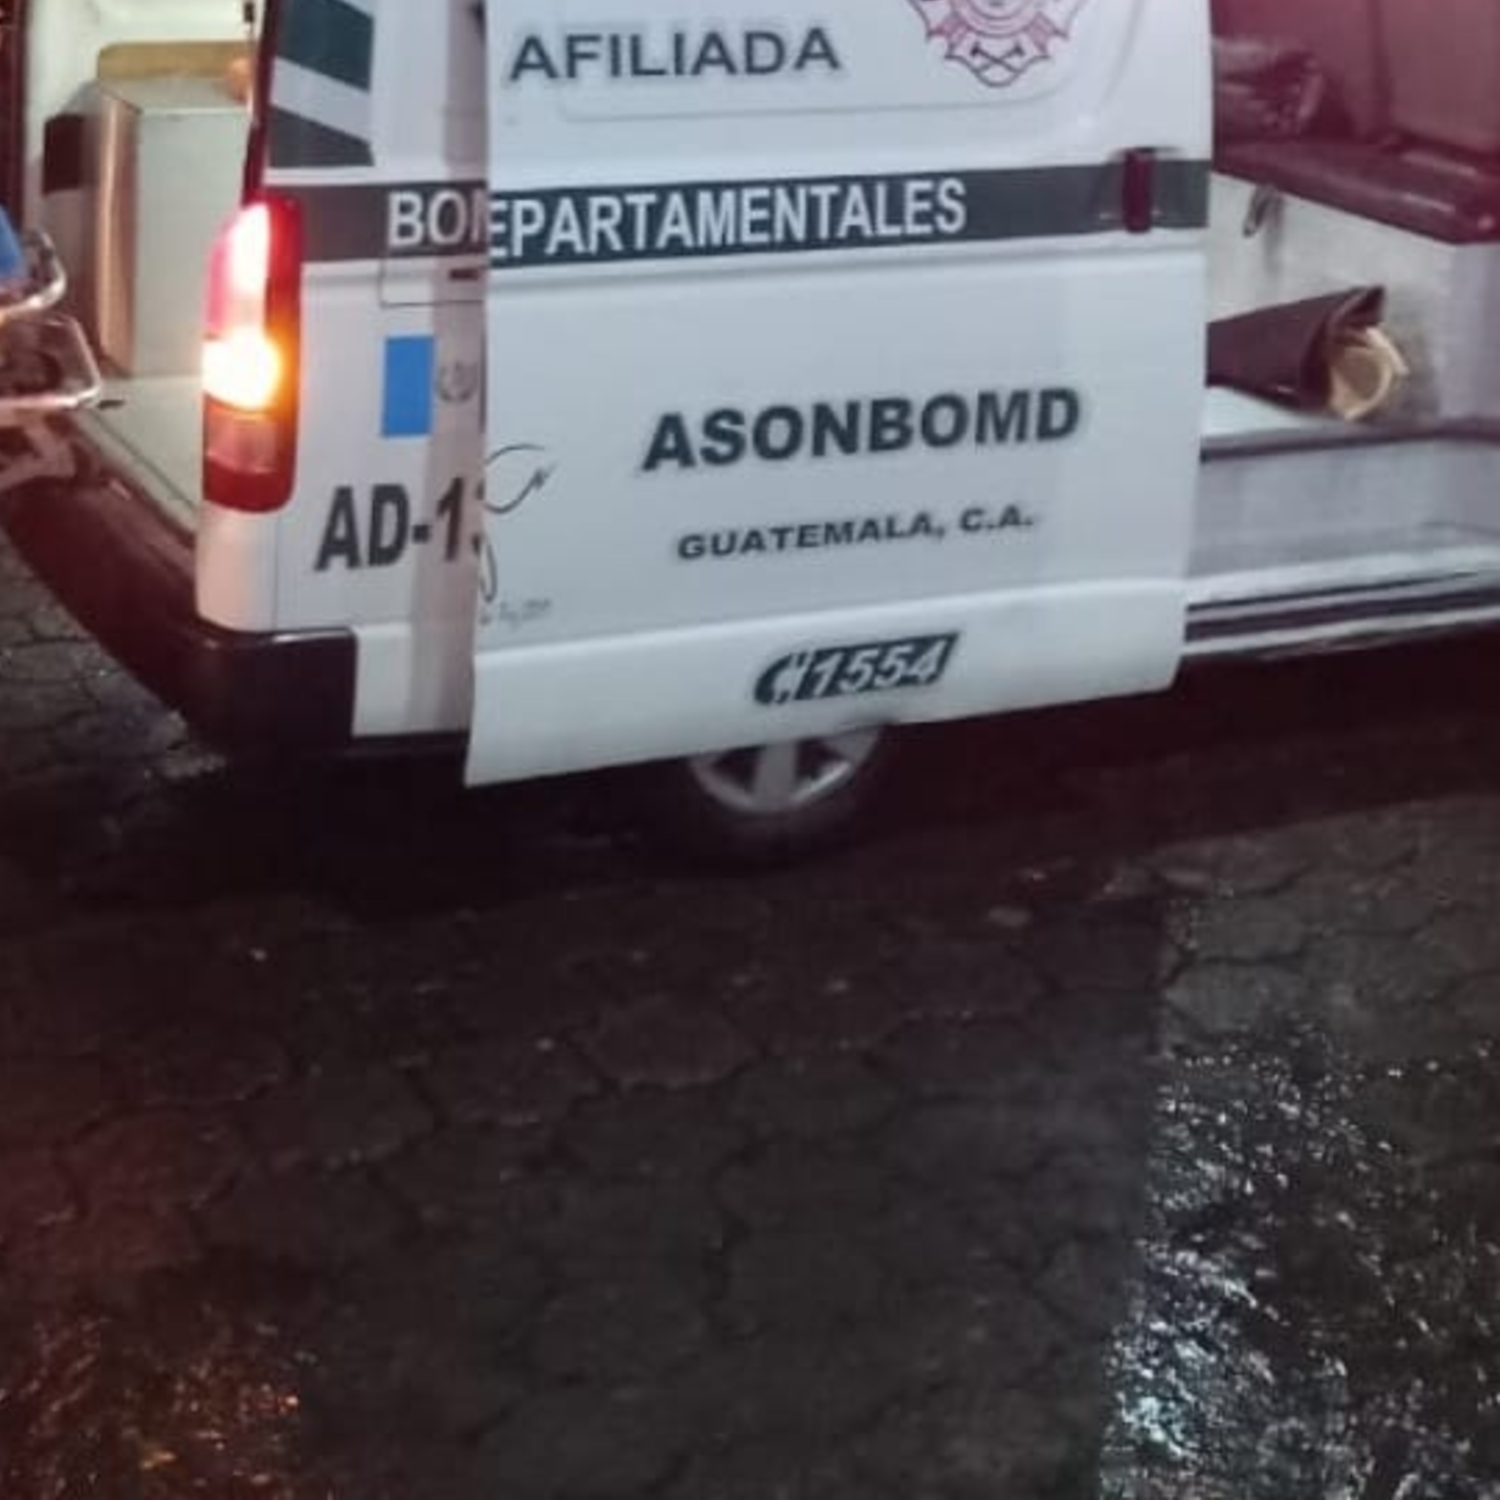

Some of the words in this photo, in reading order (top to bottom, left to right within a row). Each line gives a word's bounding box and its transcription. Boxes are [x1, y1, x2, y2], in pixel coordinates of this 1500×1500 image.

[510, 27, 841, 81] AFILIADA
[488, 179, 967, 257] EPARTAMENTALES
[641, 387, 1081, 471] ASONBOMD
[313, 476, 485, 571] AD-1
[677, 511, 946, 559] GUATEMALA,
[959, 504, 1034, 533] C.A.
